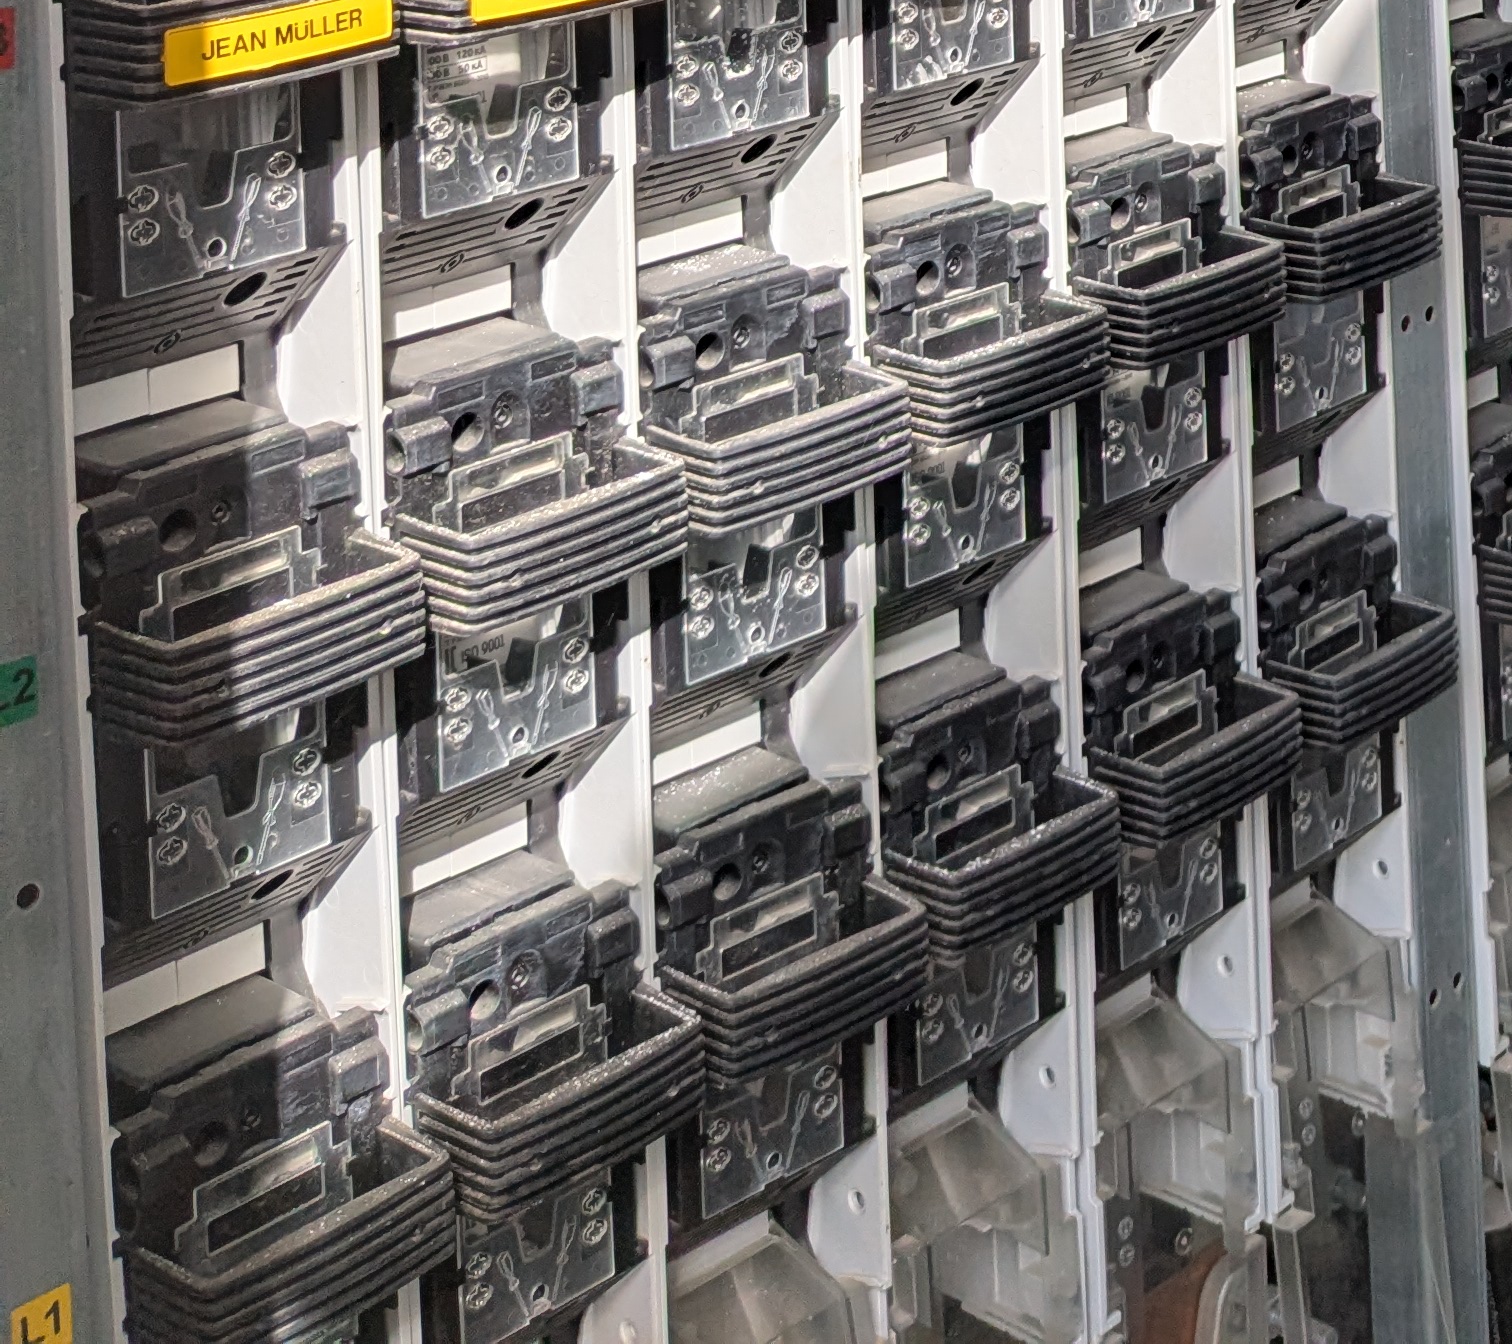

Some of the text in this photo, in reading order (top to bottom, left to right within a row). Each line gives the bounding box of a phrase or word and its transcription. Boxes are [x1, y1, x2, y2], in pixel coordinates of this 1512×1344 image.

[201, 8, 364, 61] JEAN MÜLLER
[481, 633, 505, 655] 9001
[21, 1300, 61, 1344] L1
